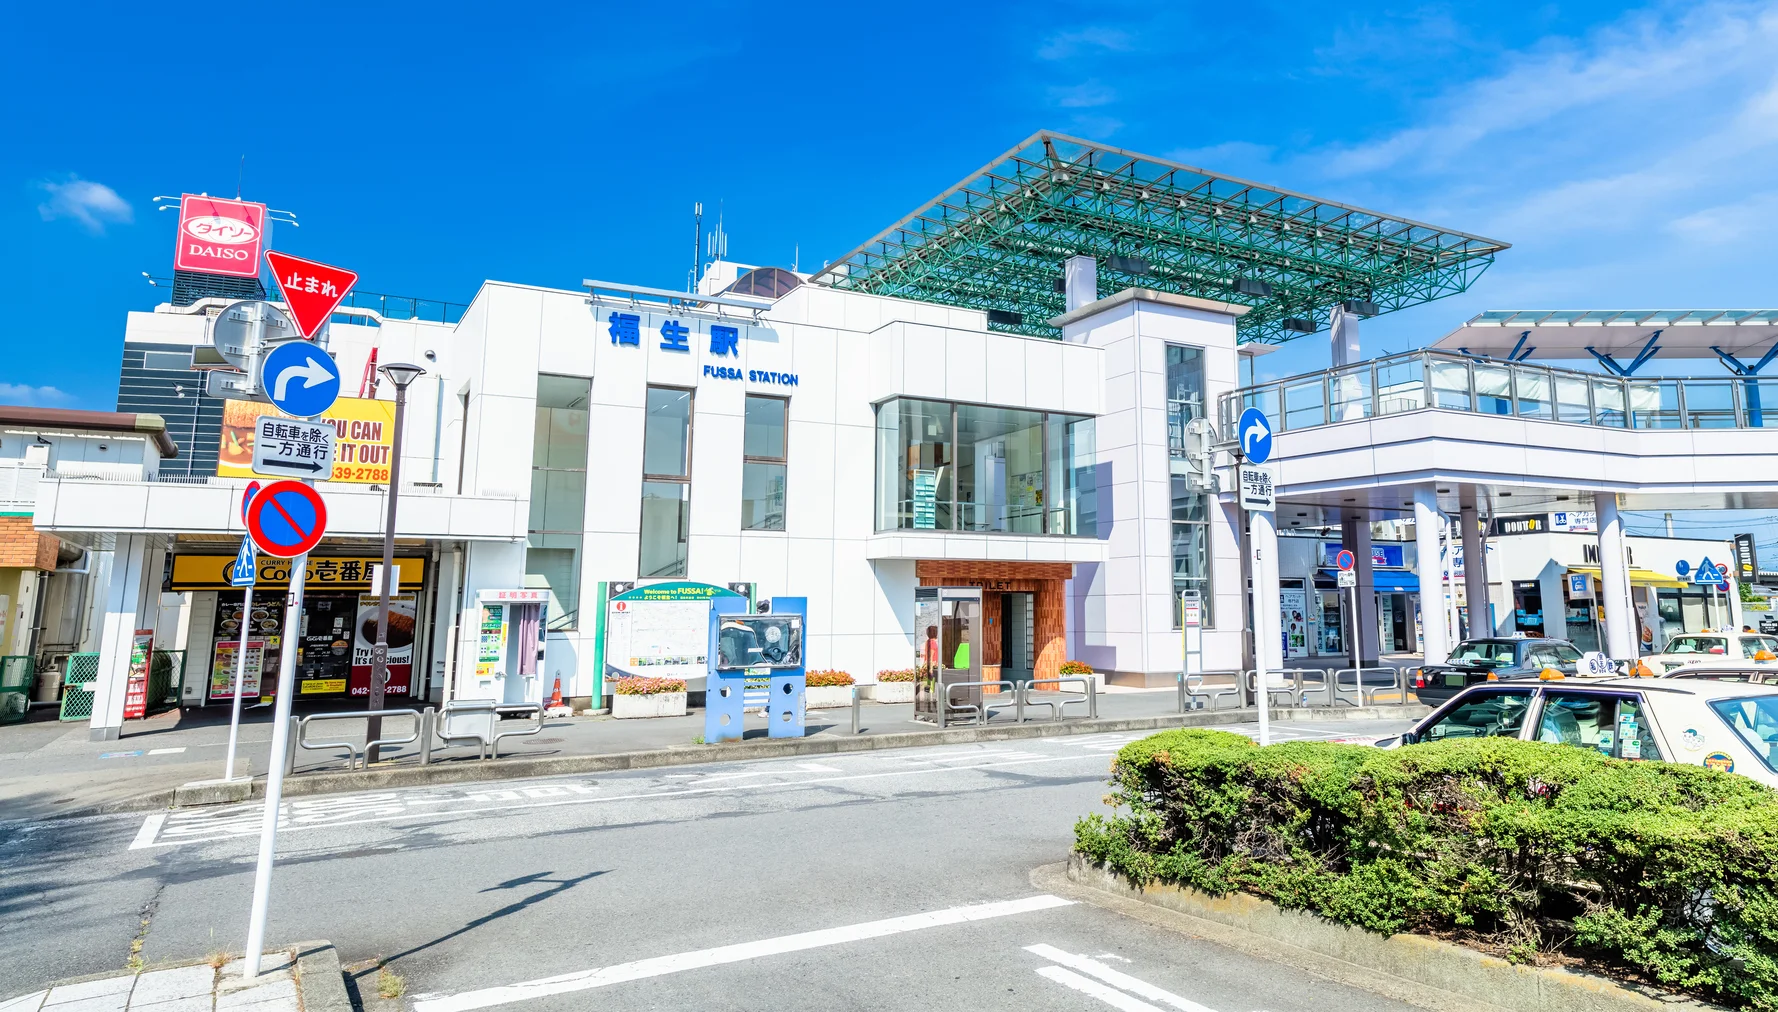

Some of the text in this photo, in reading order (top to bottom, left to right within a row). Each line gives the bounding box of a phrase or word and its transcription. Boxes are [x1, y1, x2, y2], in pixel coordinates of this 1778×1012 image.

[189, 244, 248, 260] DAISO
[284, 272, 339, 298] 止まれ
[608, 311, 739, 357] 福生駅
[703, 365, 799, 386] FUSSA STATION
[262, 422, 329, 444] 自転車を除く
[350, 420, 382, 441] CAN
[261, 442, 328, 460] 一方通行
[340, 444, 357, 463] IT
[358, 445, 390, 465] OUT
[332, 466, 389, 481] 39-2788
[1243, 484, 1272, 497] 一方通行
[1504, 519, 1542, 533] DOUTOR
[1739, 541, 1754, 577] DOUTOR
[356, 648, 369, 656] Try
